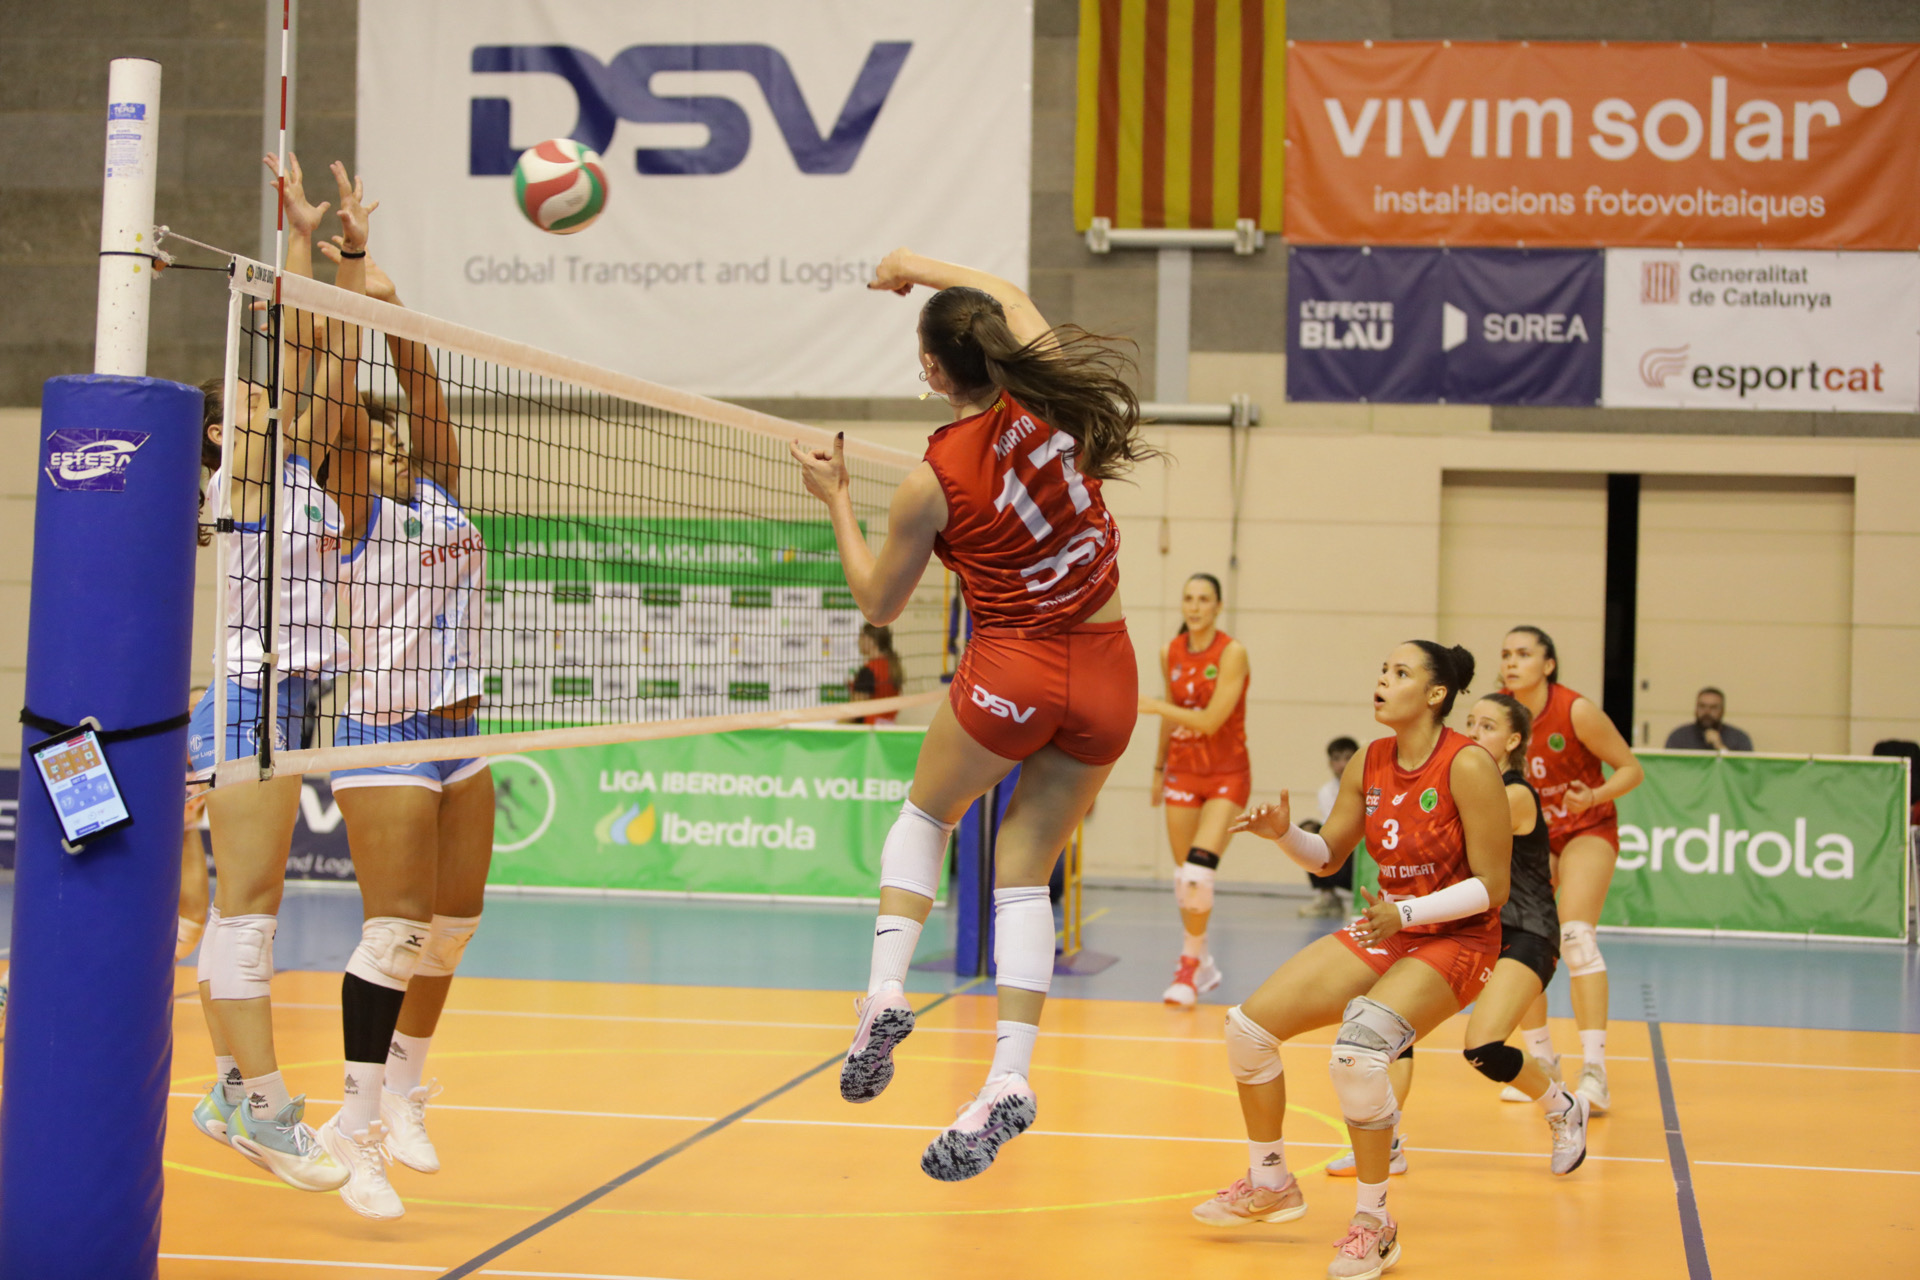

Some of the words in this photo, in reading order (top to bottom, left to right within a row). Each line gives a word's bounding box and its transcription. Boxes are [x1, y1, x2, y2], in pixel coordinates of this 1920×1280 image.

[470, 41, 913, 176] DSV
[1324, 98, 1573, 159] vivim
[1589, 75, 1842, 161] solar
[1584, 185, 1827, 225] fotovoltaiques
[464, 256, 555, 286] Global
[565, 256, 706, 290] Transport
[717, 256, 770, 285] and
[780, 256, 878, 290] Logisti
[1690, 263, 1809, 286] Generalitat
[1690, 288, 1717, 308] de
[1722, 288, 1832, 311] Catalunya
[1300, 321, 1394, 350] BLAU
[1483, 314, 1589, 345] SOREA
[1691, 360, 1885, 398] esportcat
[993, 415, 1037, 461] MARTA
[993, 429, 1092, 543] 17
[421, 533, 484, 568] arena
[971, 684, 1037, 724] DSV
[600, 769, 657, 793] LIGA
[661, 771, 809, 799] IBERDROLA
[661, 812, 816, 850] Iberdrola
[1381, 818, 1399, 850] 3
[1616, 813, 1855, 880] erdrola
[1399, 862, 1436, 879] CUGAT
